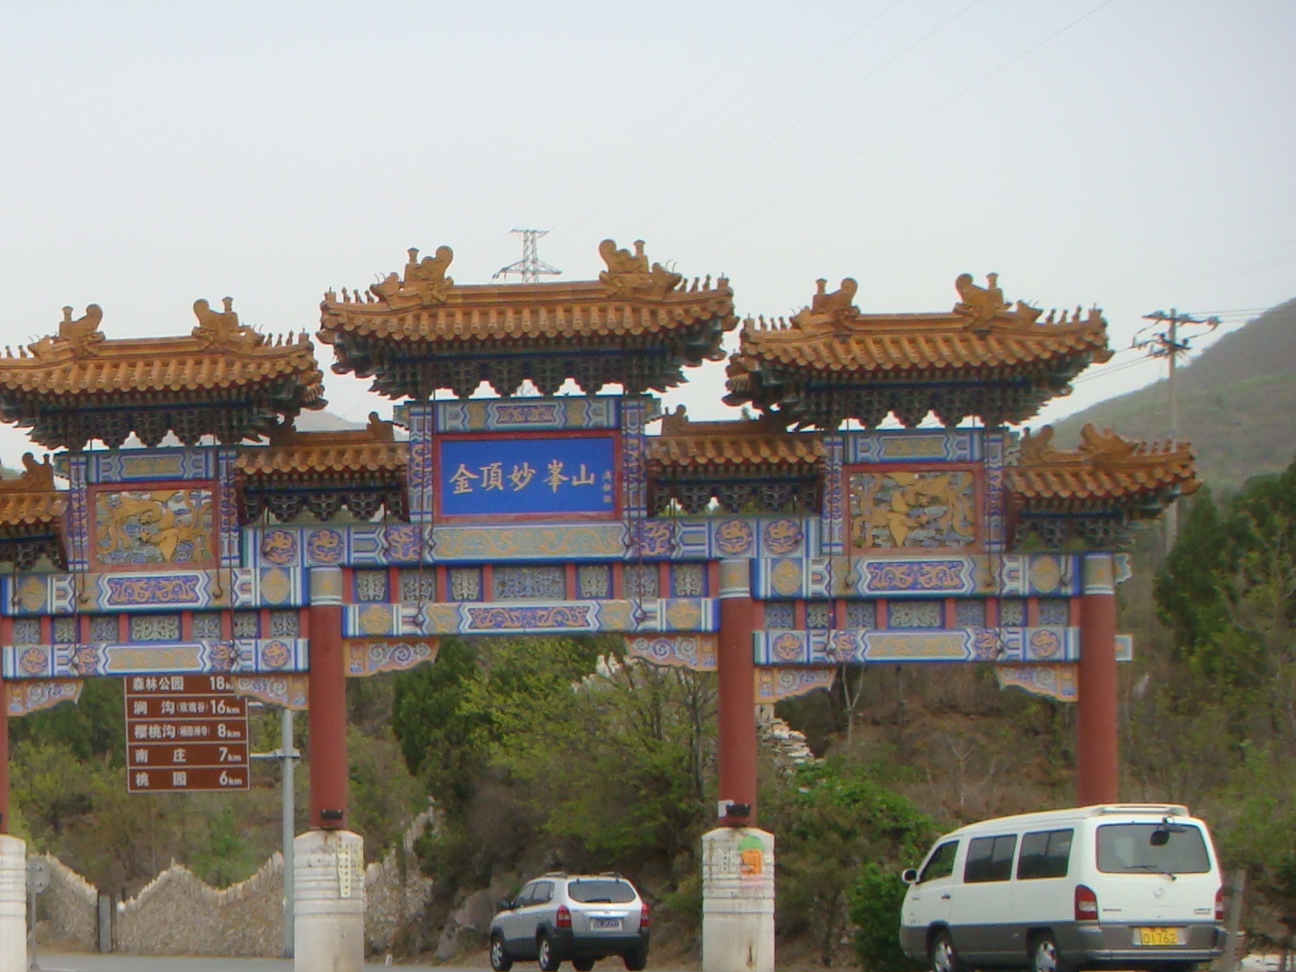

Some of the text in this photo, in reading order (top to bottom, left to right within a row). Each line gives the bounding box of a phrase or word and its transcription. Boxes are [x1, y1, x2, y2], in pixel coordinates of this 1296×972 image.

[217, 723, 241, 738] 8km
[219, 747, 242, 762] 7km
[219, 771, 243, 786] 6km
